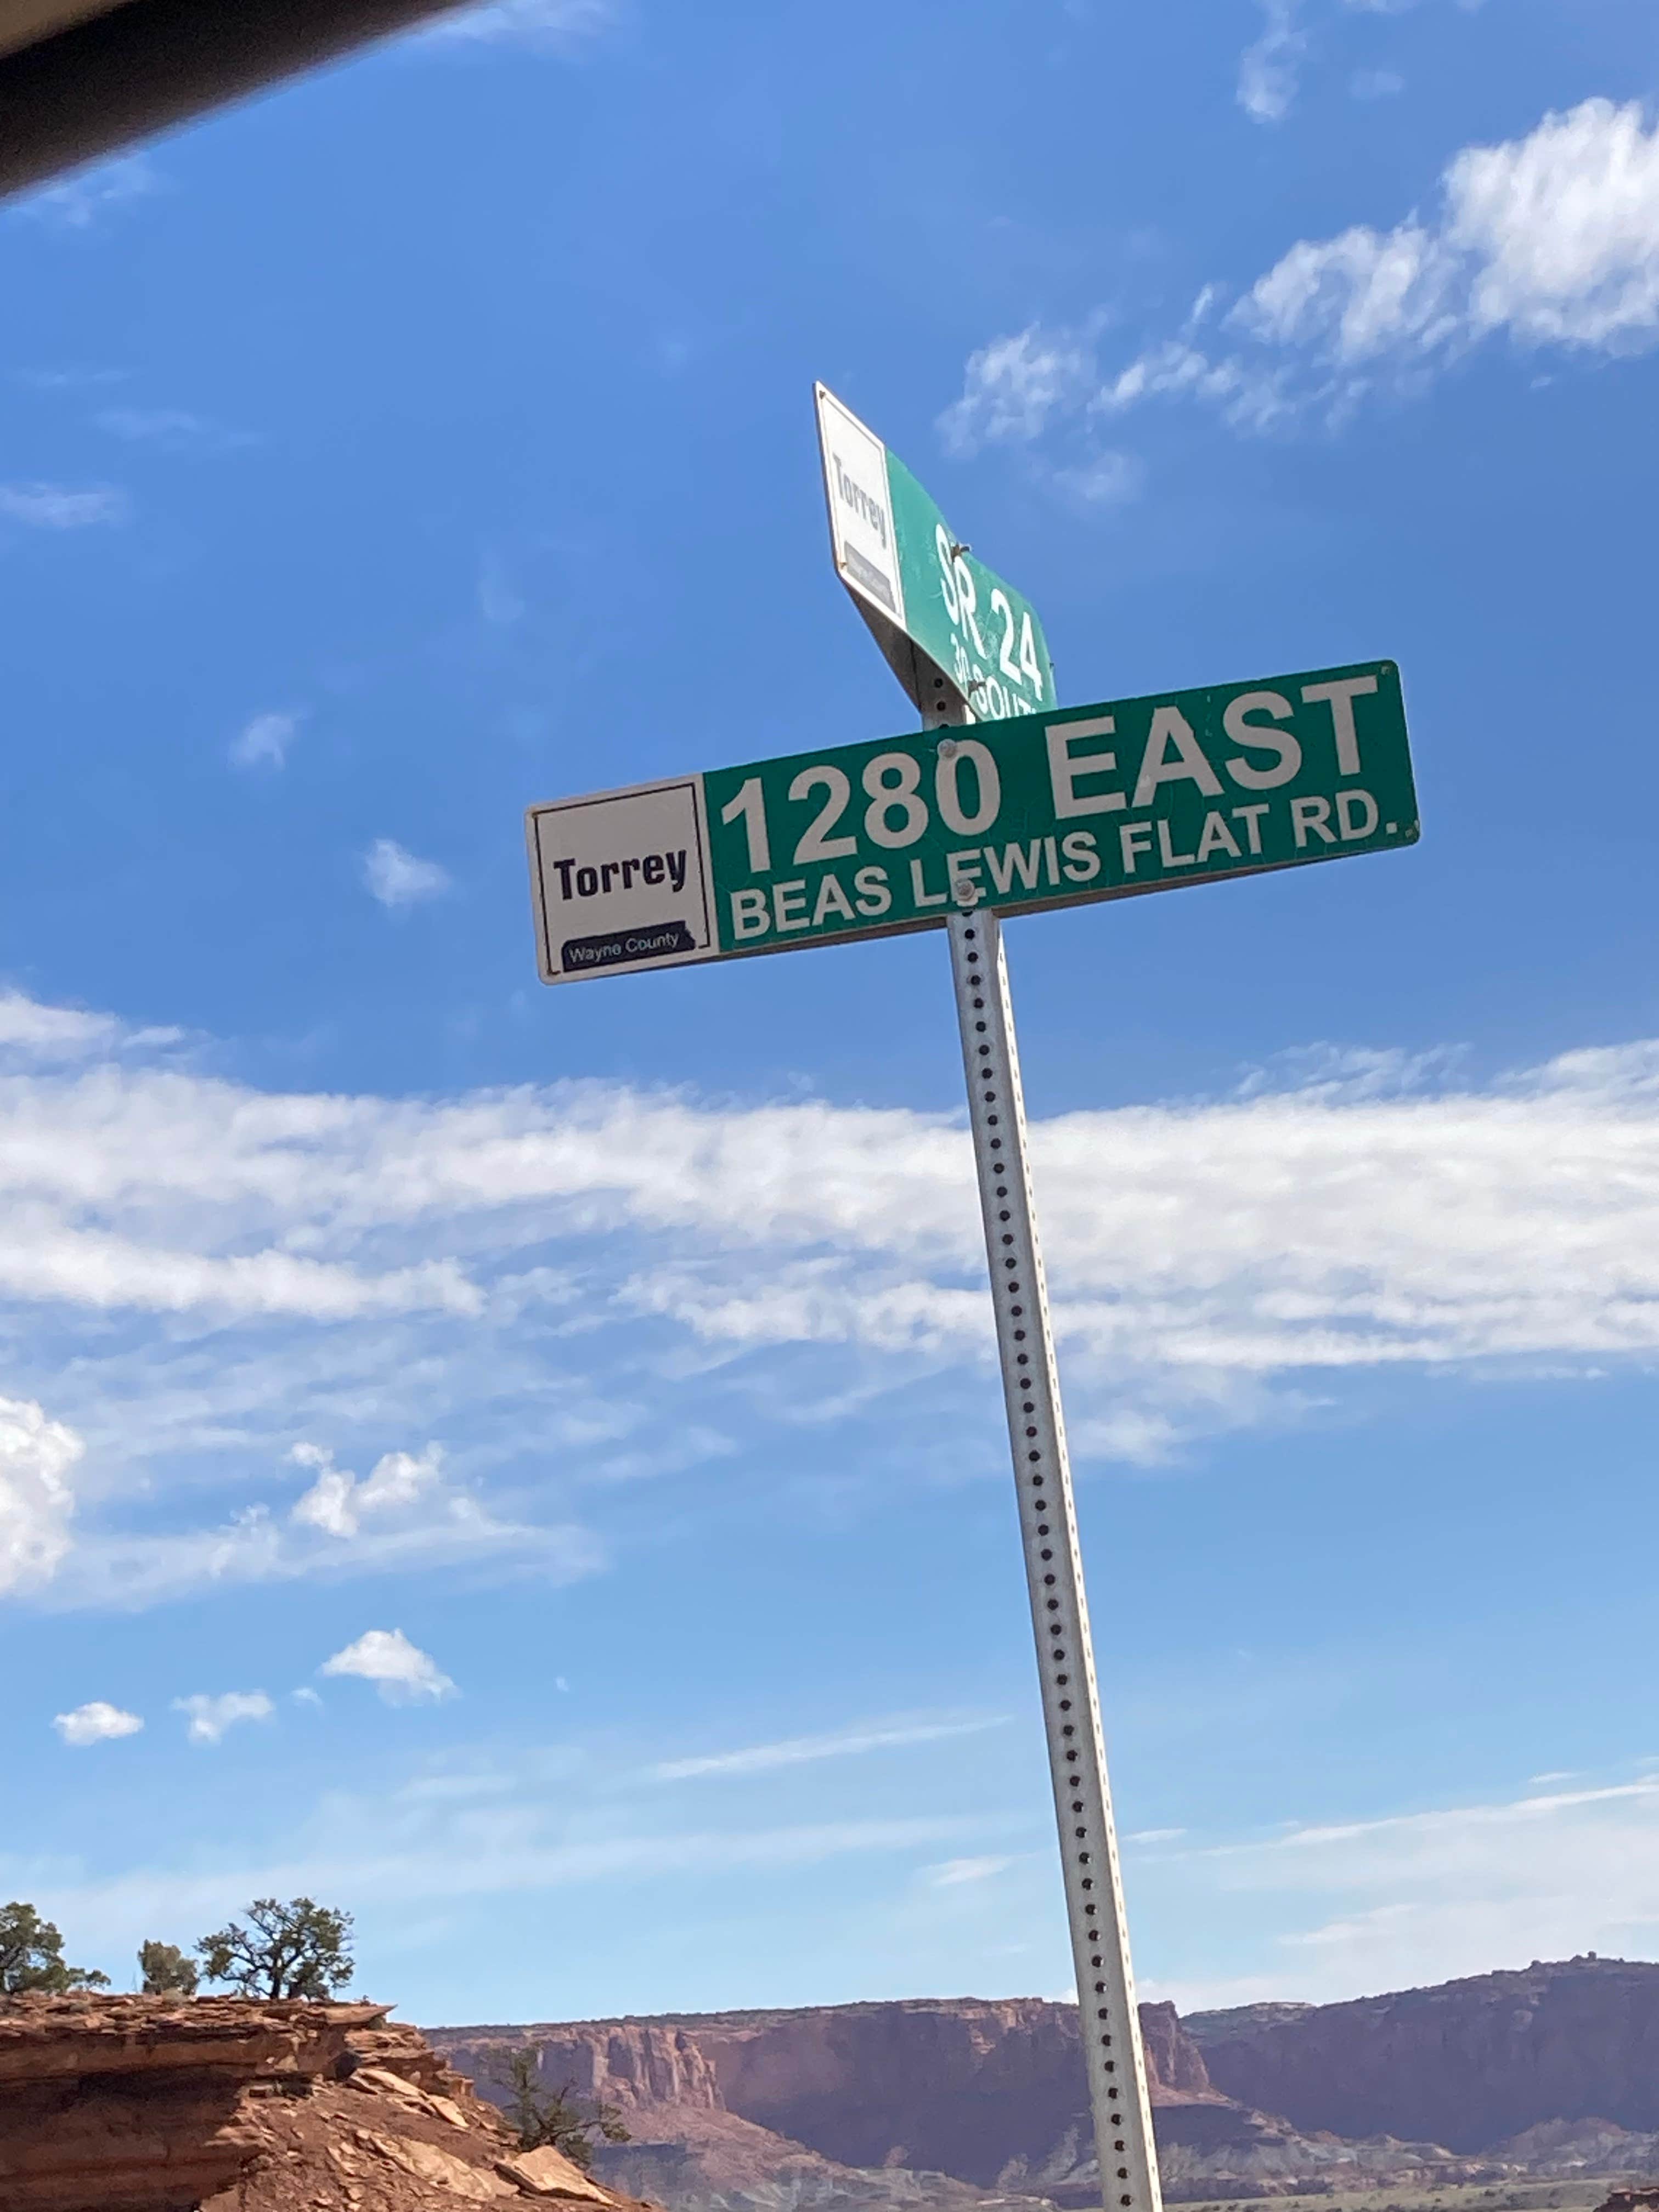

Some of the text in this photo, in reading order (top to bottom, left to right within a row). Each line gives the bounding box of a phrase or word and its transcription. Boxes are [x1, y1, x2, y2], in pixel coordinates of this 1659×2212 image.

[832, 452, 887, 550] Torrey
[936, 523, 988, 659] SR
[991, 588, 1043, 702] 24
[721, 675, 1378, 874] 1280 EAST
[553, 849, 687, 901] Torrey
[730, 788, 1398, 941] BEAS LEWIS FLAT RD.
[568, 932, 679, 963] Wayne County
